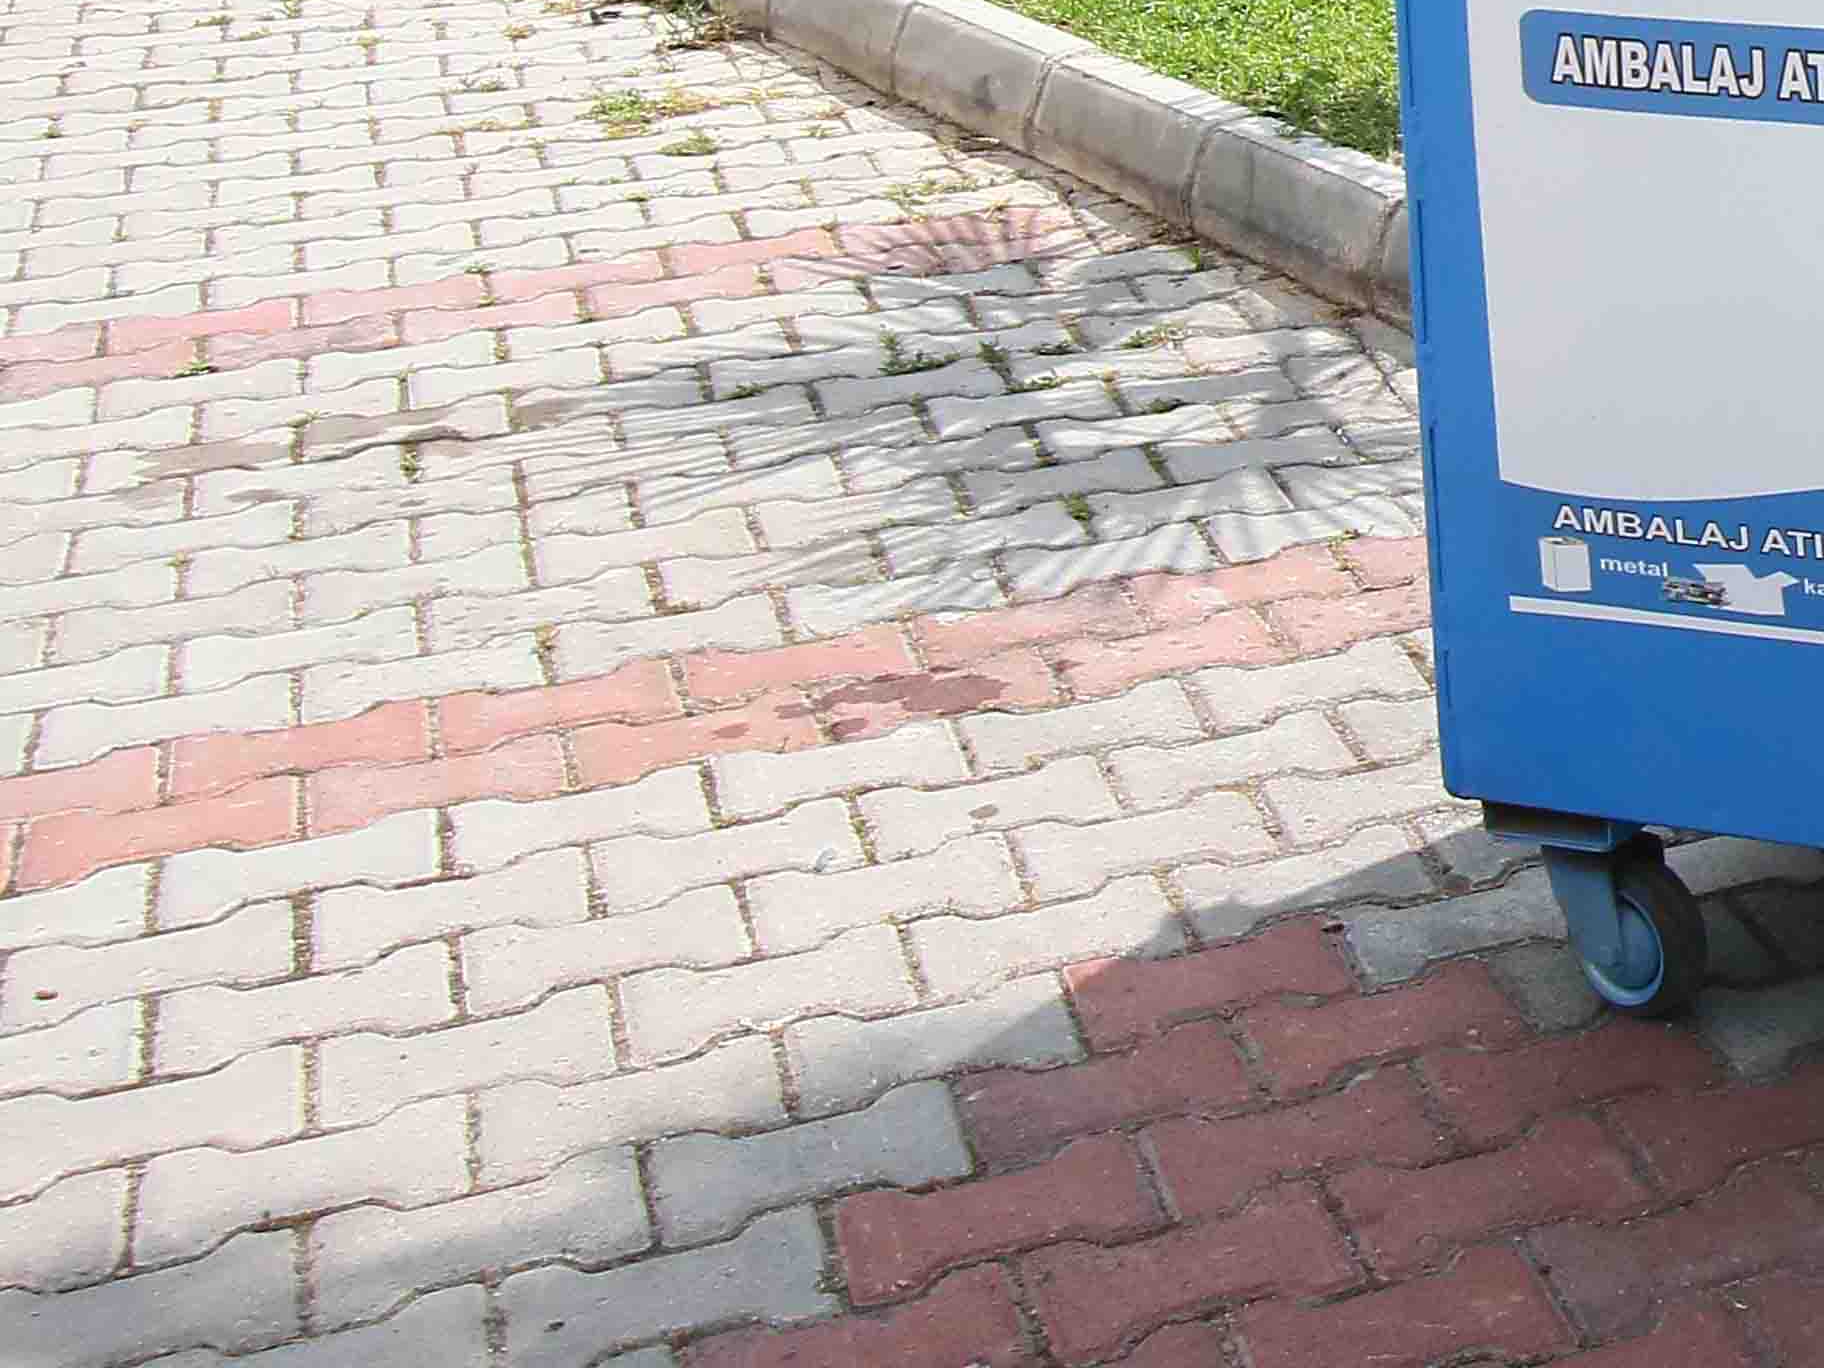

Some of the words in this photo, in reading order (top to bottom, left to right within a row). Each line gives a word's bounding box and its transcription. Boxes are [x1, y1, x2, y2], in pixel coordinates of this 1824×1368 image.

[1551, 34, 1765, 99] AMBALAJ
[1552, 504, 1750, 552] AMBALAJ
[1600, 555, 1669, 578] metal
